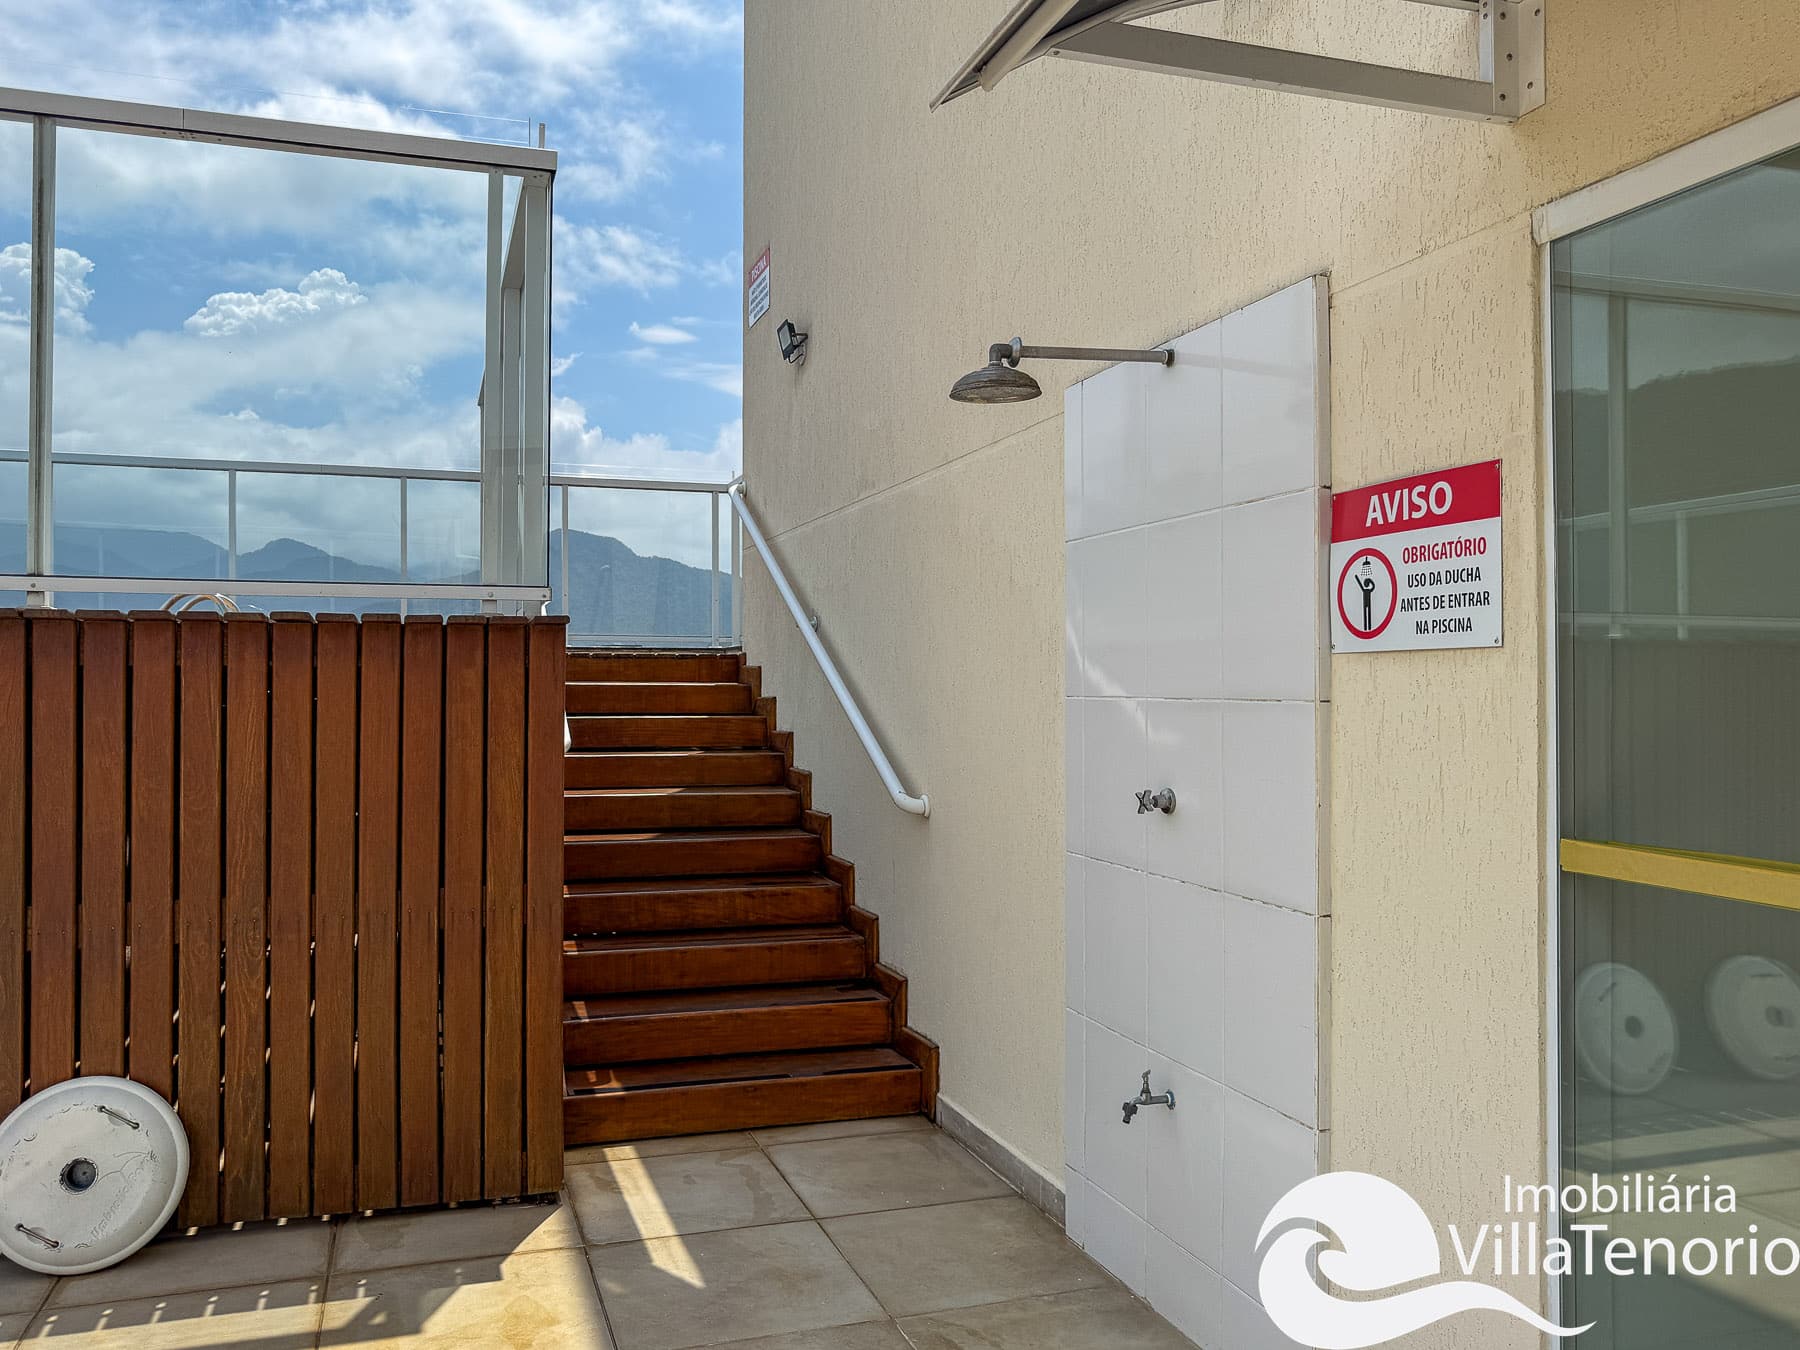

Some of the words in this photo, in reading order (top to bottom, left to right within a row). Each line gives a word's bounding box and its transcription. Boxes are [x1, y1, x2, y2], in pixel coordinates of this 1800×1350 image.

[1365, 481, 1453, 527] AVISO
[1402, 536, 1487, 565] OBRIGATÓRIO
[1407, 573, 1427, 588] USO
[1429, 571, 1442, 586] DA
[1445, 567, 1481, 584] DUCHA
[1400, 596, 1430, 612] ANTES
[1433, 594, 1445, 609] DE
[1448, 591, 1490, 608] ENTRAR
[1416, 620, 1429, 634] NA
[1432, 617, 1473, 633] PISCINA
